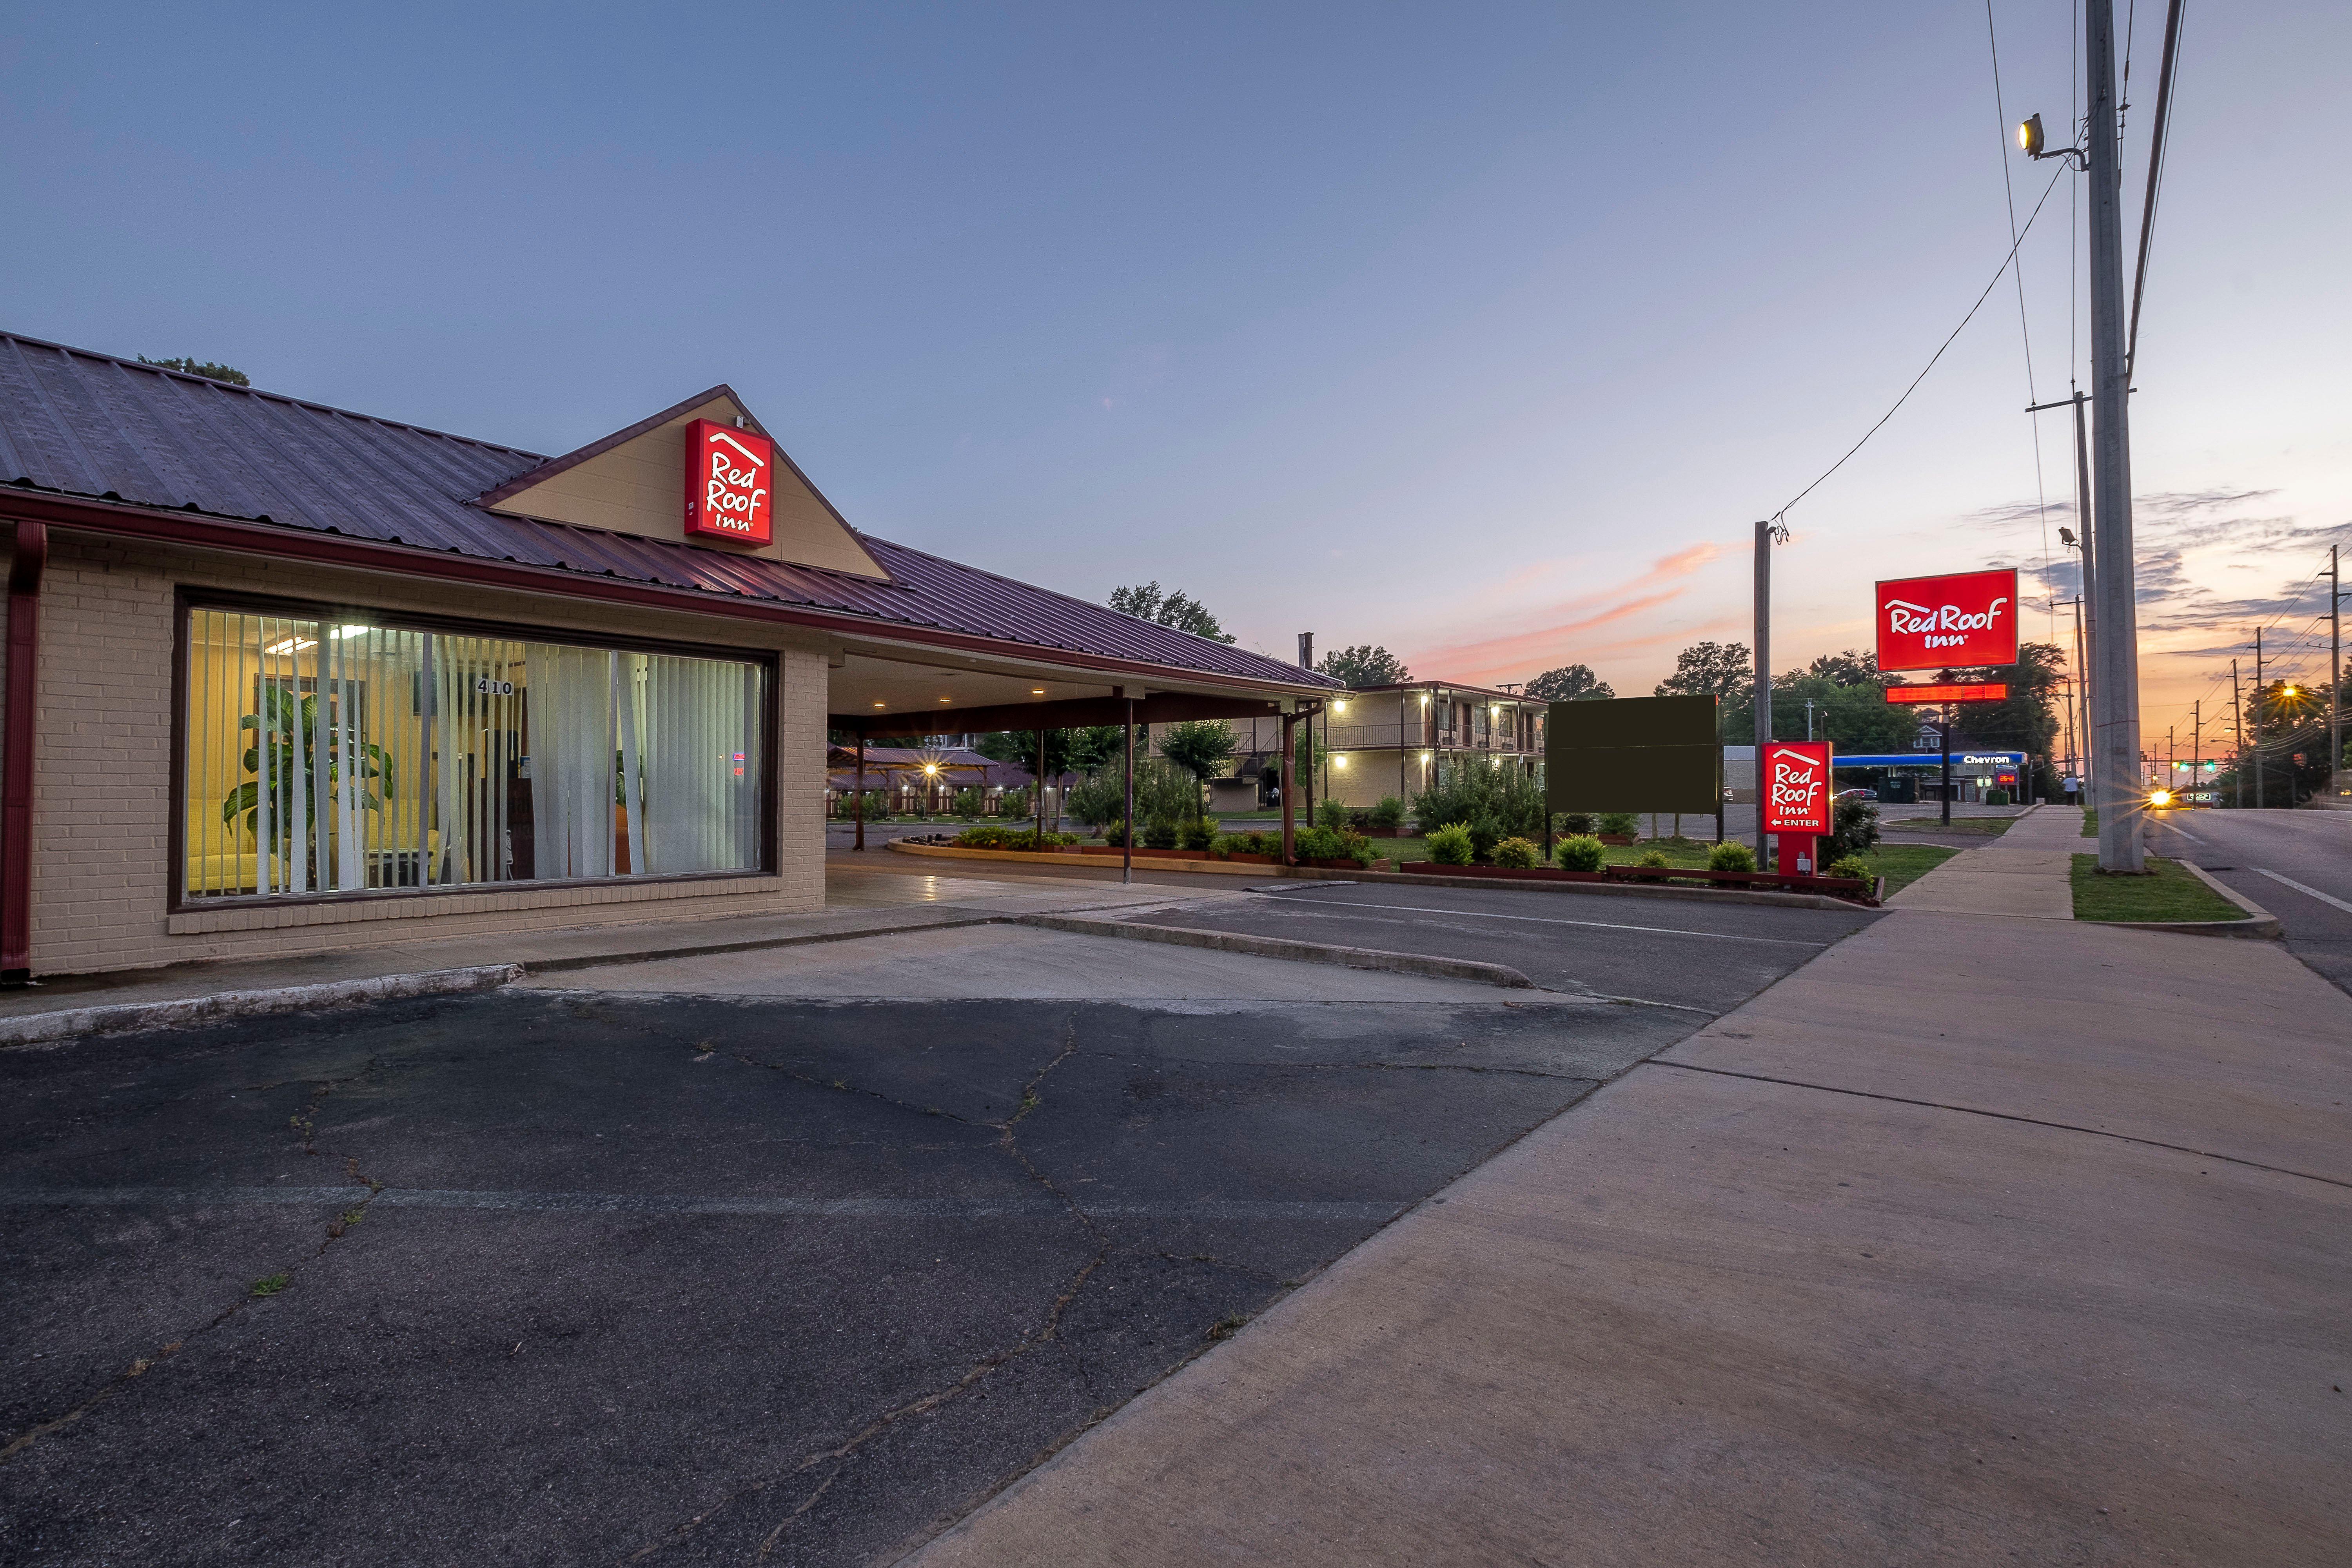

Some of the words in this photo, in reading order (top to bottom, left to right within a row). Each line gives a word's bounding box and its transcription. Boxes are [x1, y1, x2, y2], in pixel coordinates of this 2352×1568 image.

[712, 452, 756, 489] Red
[706, 480, 766, 521] Roof
[478, 679, 512, 695] 410
[1964, 755, 2010, 764] Chevron
[1775, 763, 1813, 784] Red
[1771, 781, 1822, 806] Roof
